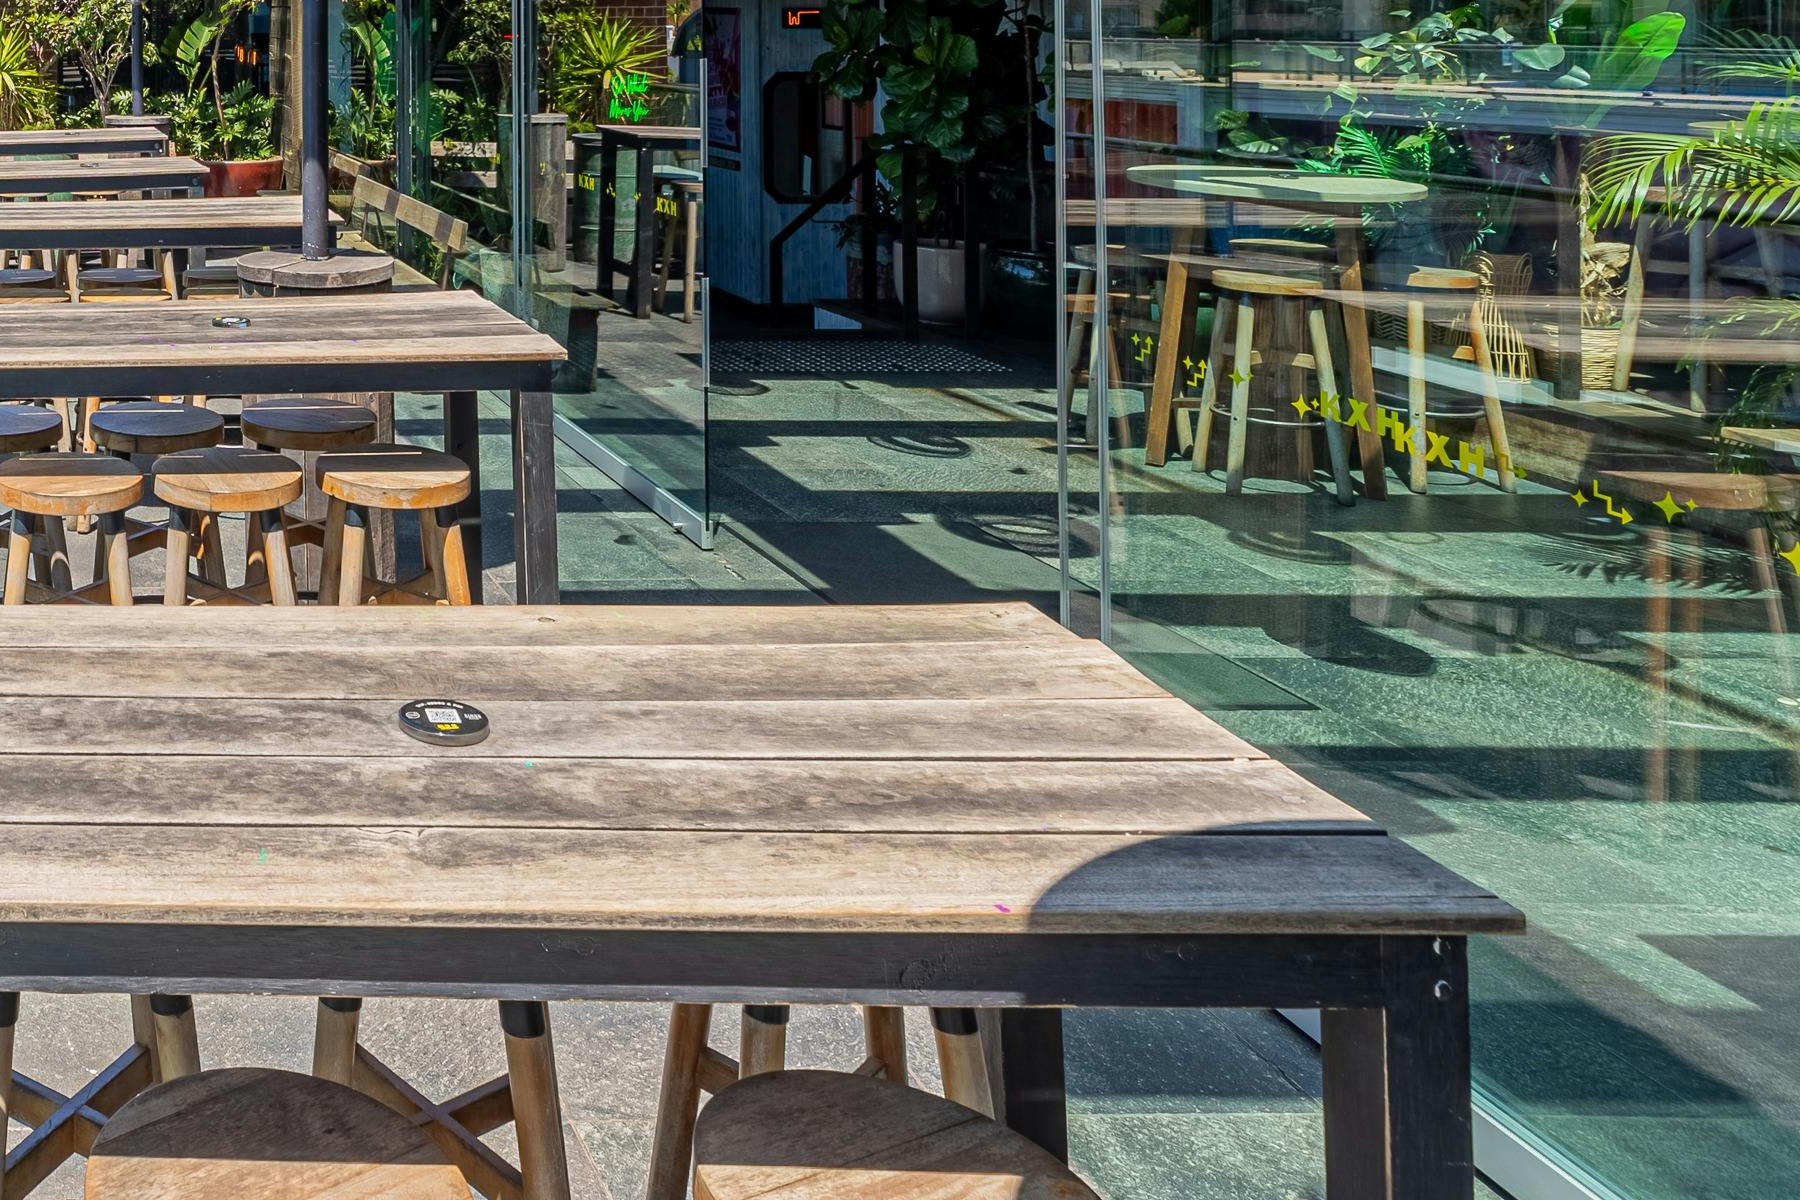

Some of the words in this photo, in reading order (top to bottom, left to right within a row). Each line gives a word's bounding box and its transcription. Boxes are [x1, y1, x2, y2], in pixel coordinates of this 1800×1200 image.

[578, 174, 595, 191] KXH
[656, 196, 677, 217] KXH
[1319, 389, 1399, 440] KXH
[1394, 421, 1485, 479] KXH
